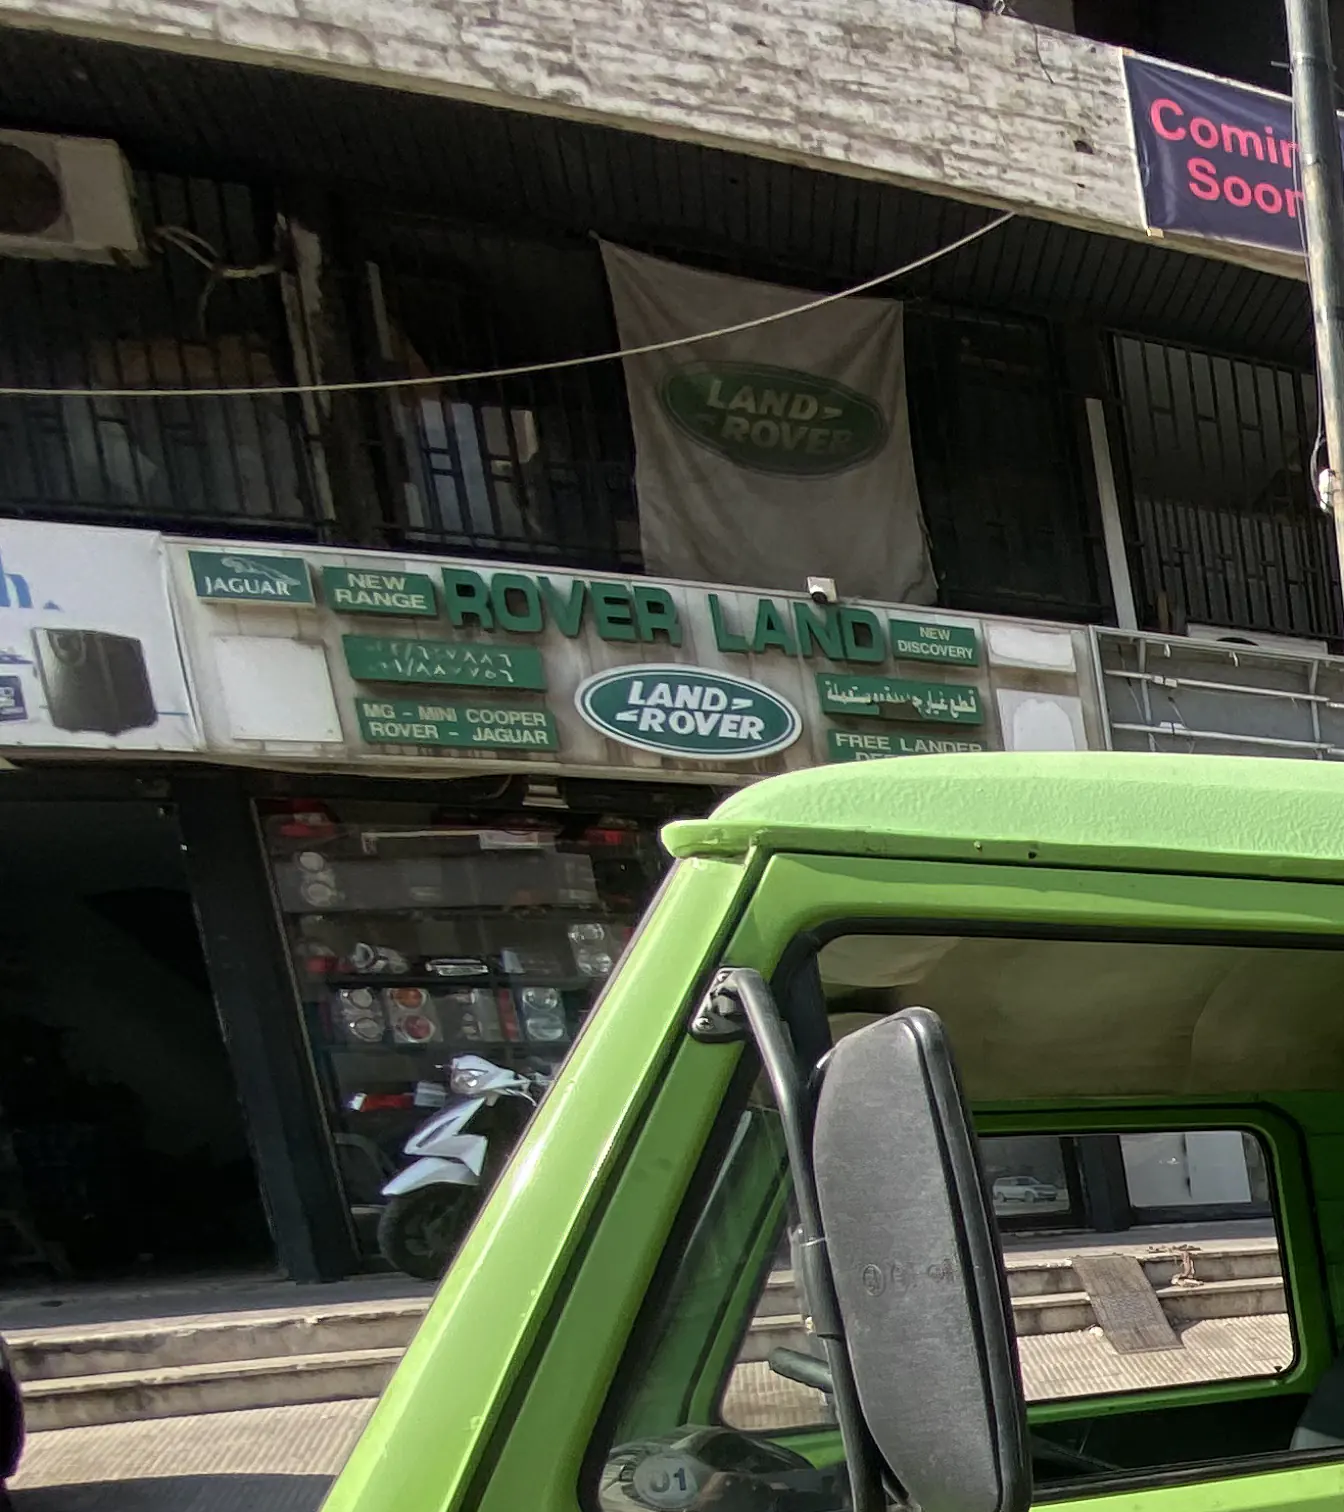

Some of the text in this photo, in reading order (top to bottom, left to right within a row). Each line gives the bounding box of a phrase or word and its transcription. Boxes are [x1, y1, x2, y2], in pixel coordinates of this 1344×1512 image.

[1150, 97, 1299, 170] Comin
[1189, 156, 1304, 219] Soon
[706, 378, 818, 420] LAND
[720, 416, 851, 452] ROVER
[204, 577, 291, 595] JAGUAR
[347, 573, 405, 591] NEW
[334, 588, 427, 609] RANGE
[441, 567, 886, 663] ROVER LAND
[919, 626, 951, 641] NEW
[897, 640, 973, 660] DISCOVERY
[628, 680, 729, 712] LAND
[925, 690, 948, 714] غيار
[949, 689, 977, 718] قطع
[363, 703, 395, 719] MG
[418, 706, 457, 722] MINI
[466, 708, 547, 727] COOPER
[635, 708, 764, 741] ROVER
[369, 722, 439, 739] ROVER
[473, 728, 549, 745] JAGUAR
[835, 733, 891, 750] FREE
